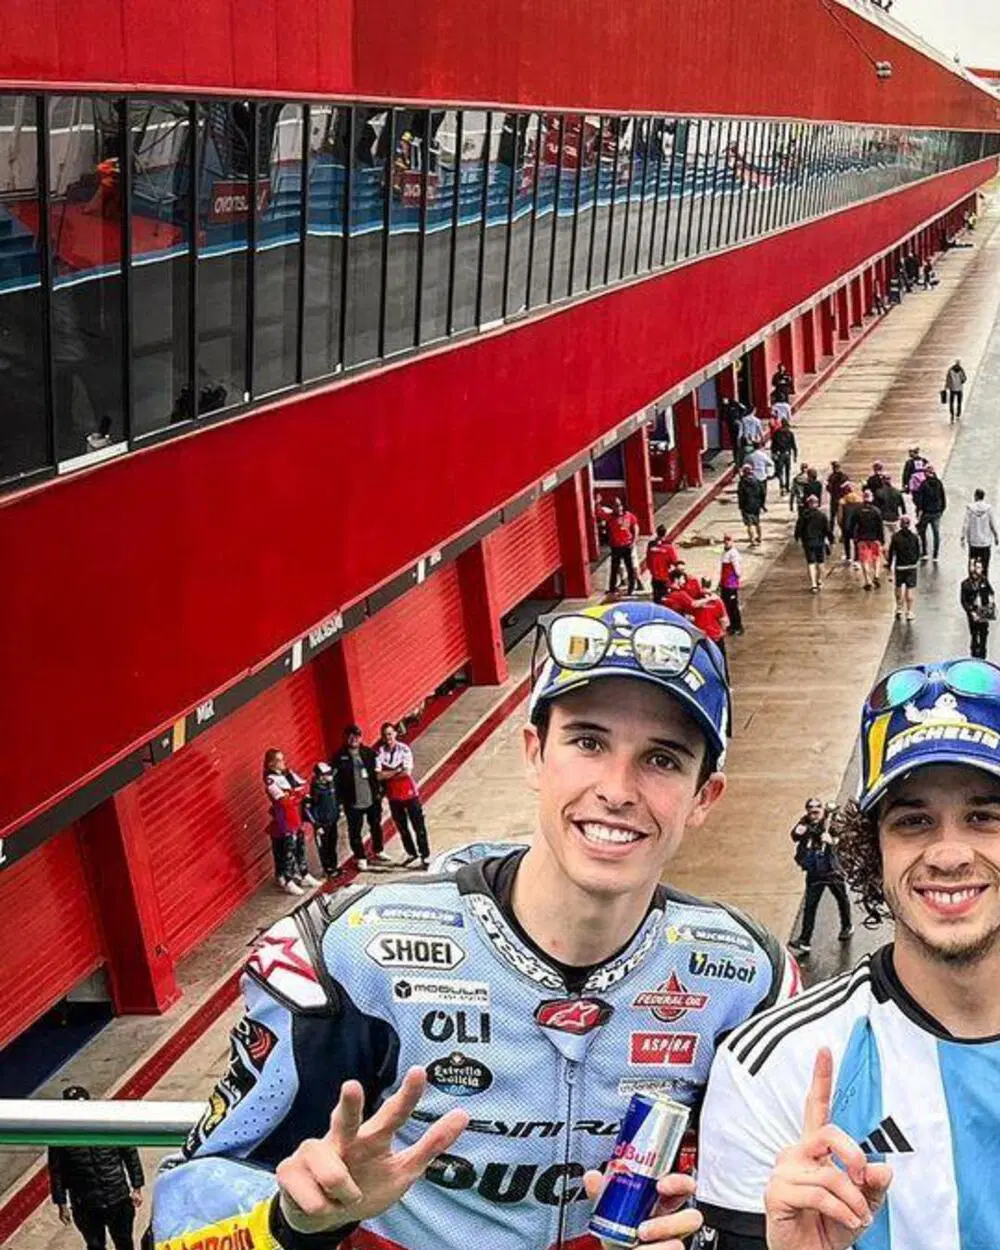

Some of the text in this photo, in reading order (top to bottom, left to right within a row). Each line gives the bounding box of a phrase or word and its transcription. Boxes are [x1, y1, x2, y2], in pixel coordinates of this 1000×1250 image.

[885, 726, 1000, 761] MICHELIN
[380, 939, 453, 964] SHOEI
[689, 951, 757, 984] Unibat
[434, 1064, 482, 1077] Estrella
[435, 1074, 479, 1087] Galicia
[424, 1153, 608, 1206] DUC
